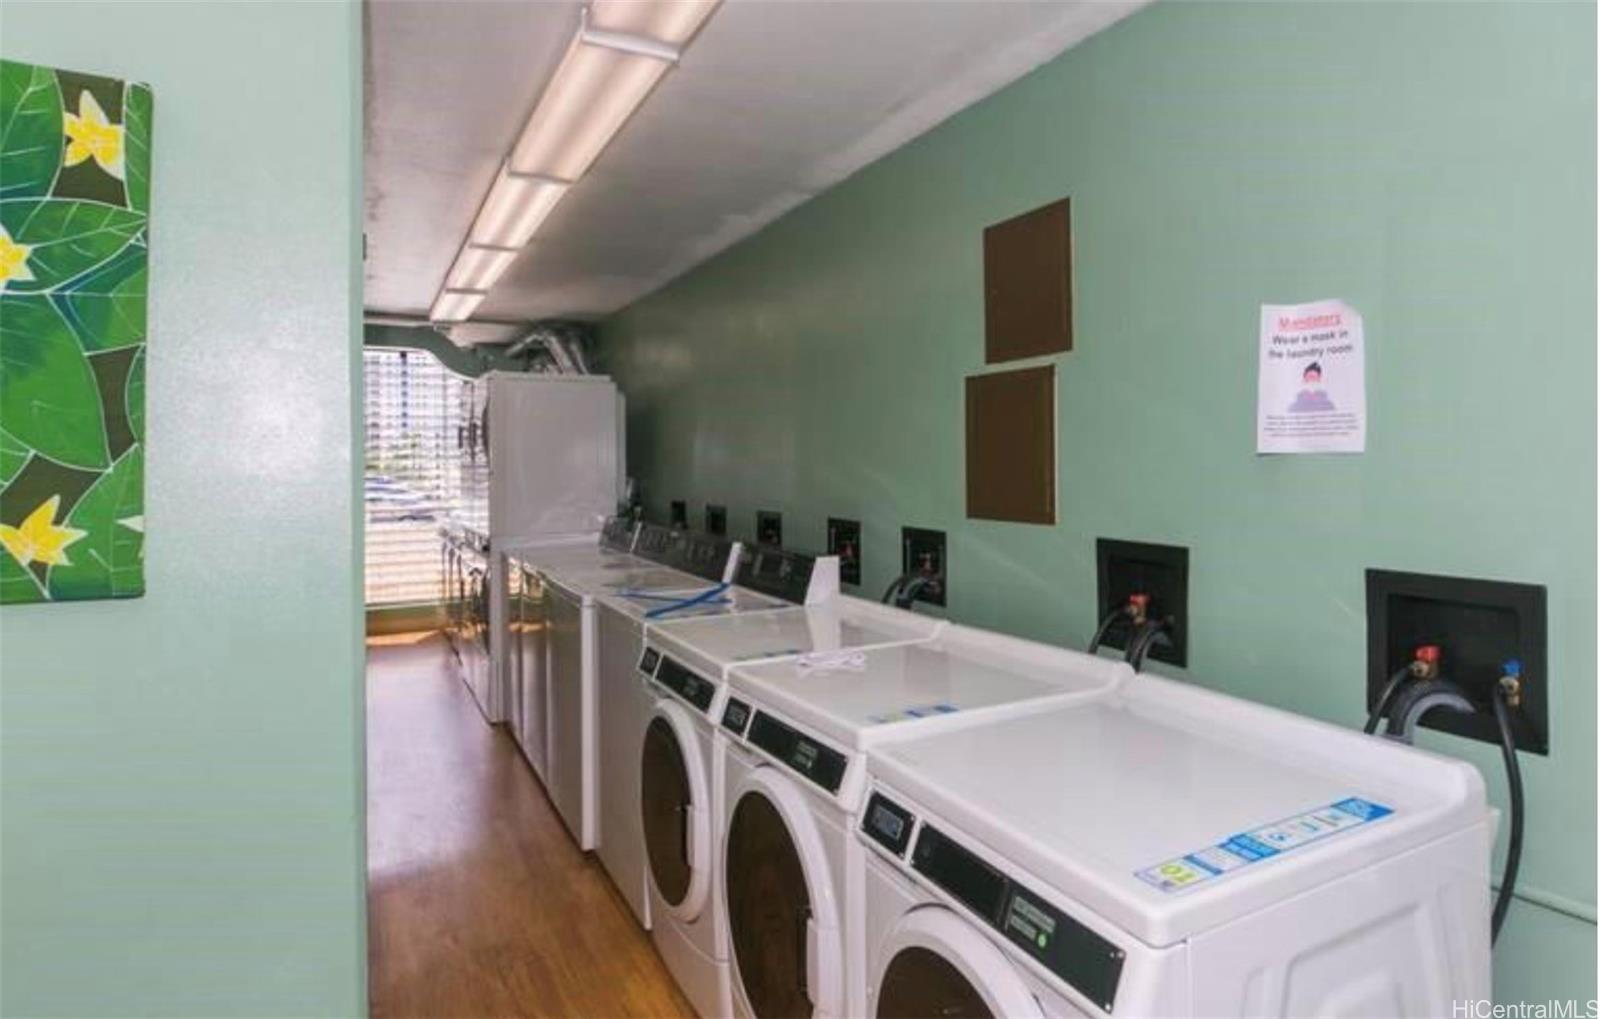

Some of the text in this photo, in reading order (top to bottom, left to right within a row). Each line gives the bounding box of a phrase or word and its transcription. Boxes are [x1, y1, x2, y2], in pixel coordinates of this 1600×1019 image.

[1272, 335, 1299, 345] Wear
[1311, 331, 1335, 341] mask
[1340, 330, 1348, 338] in
[1268, 345, 1353, 359] the laundry room
